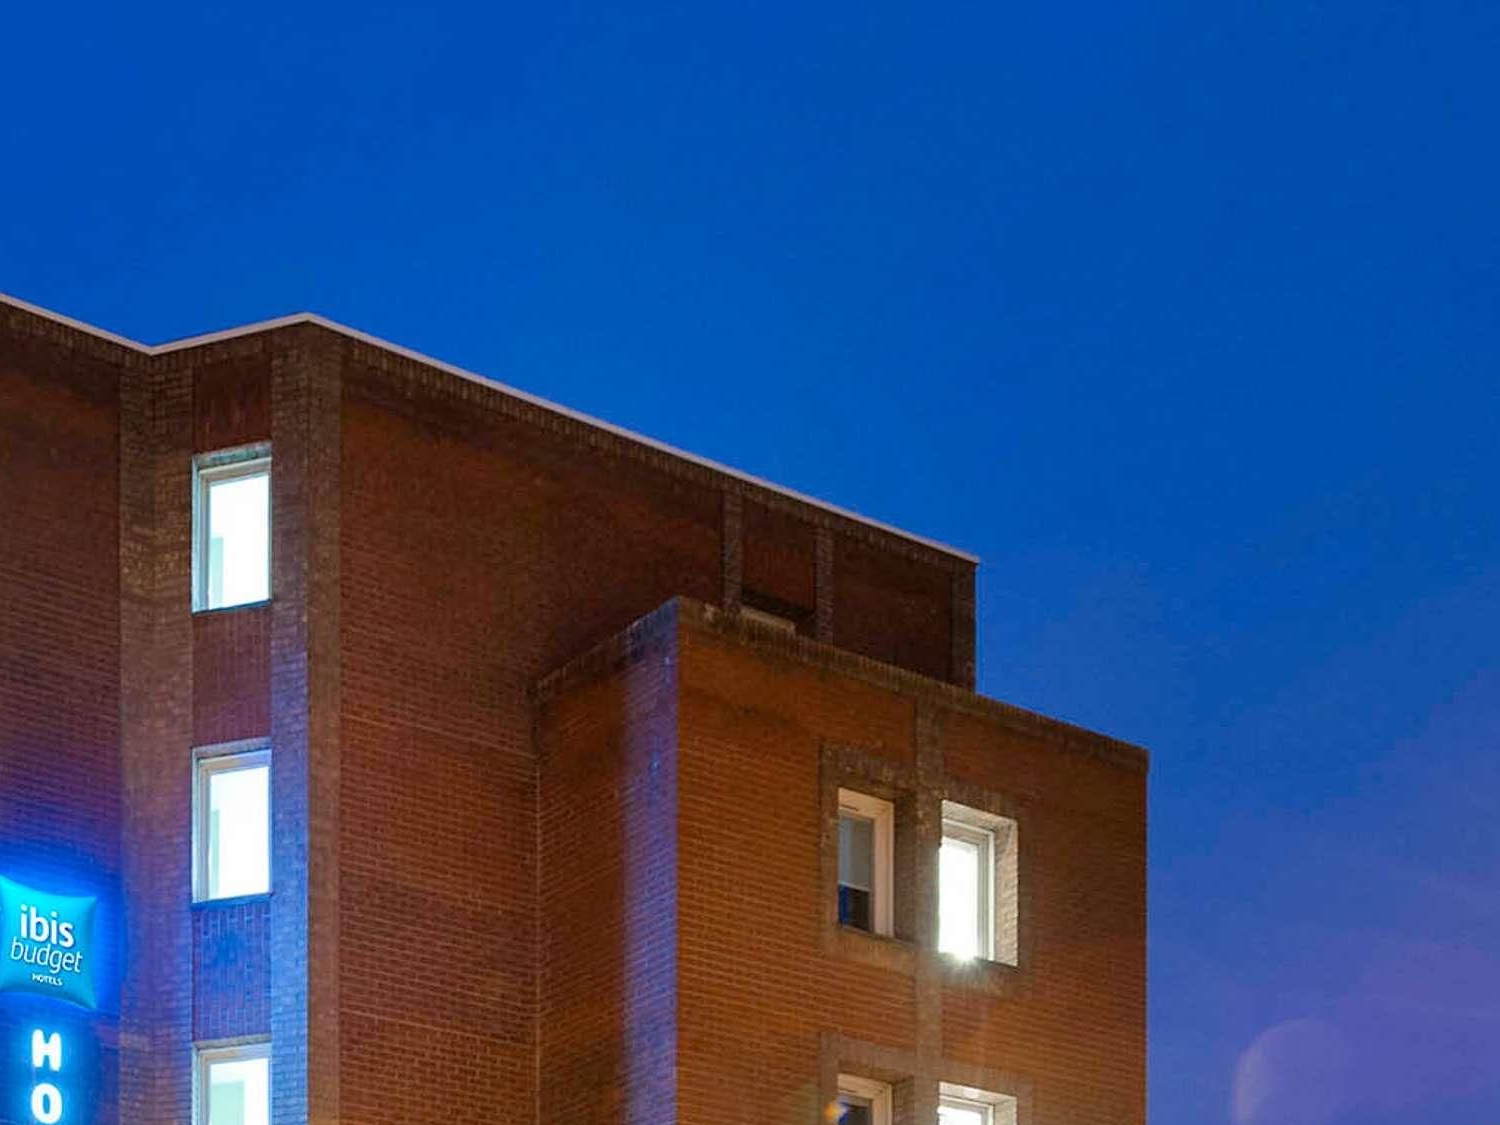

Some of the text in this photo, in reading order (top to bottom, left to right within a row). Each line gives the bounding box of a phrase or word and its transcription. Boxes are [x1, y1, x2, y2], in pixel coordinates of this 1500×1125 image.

[20, 904, 75, 948] ibis
[11, 936, 83, 974] budget
[32, 973, 63, 986] HOTELS
